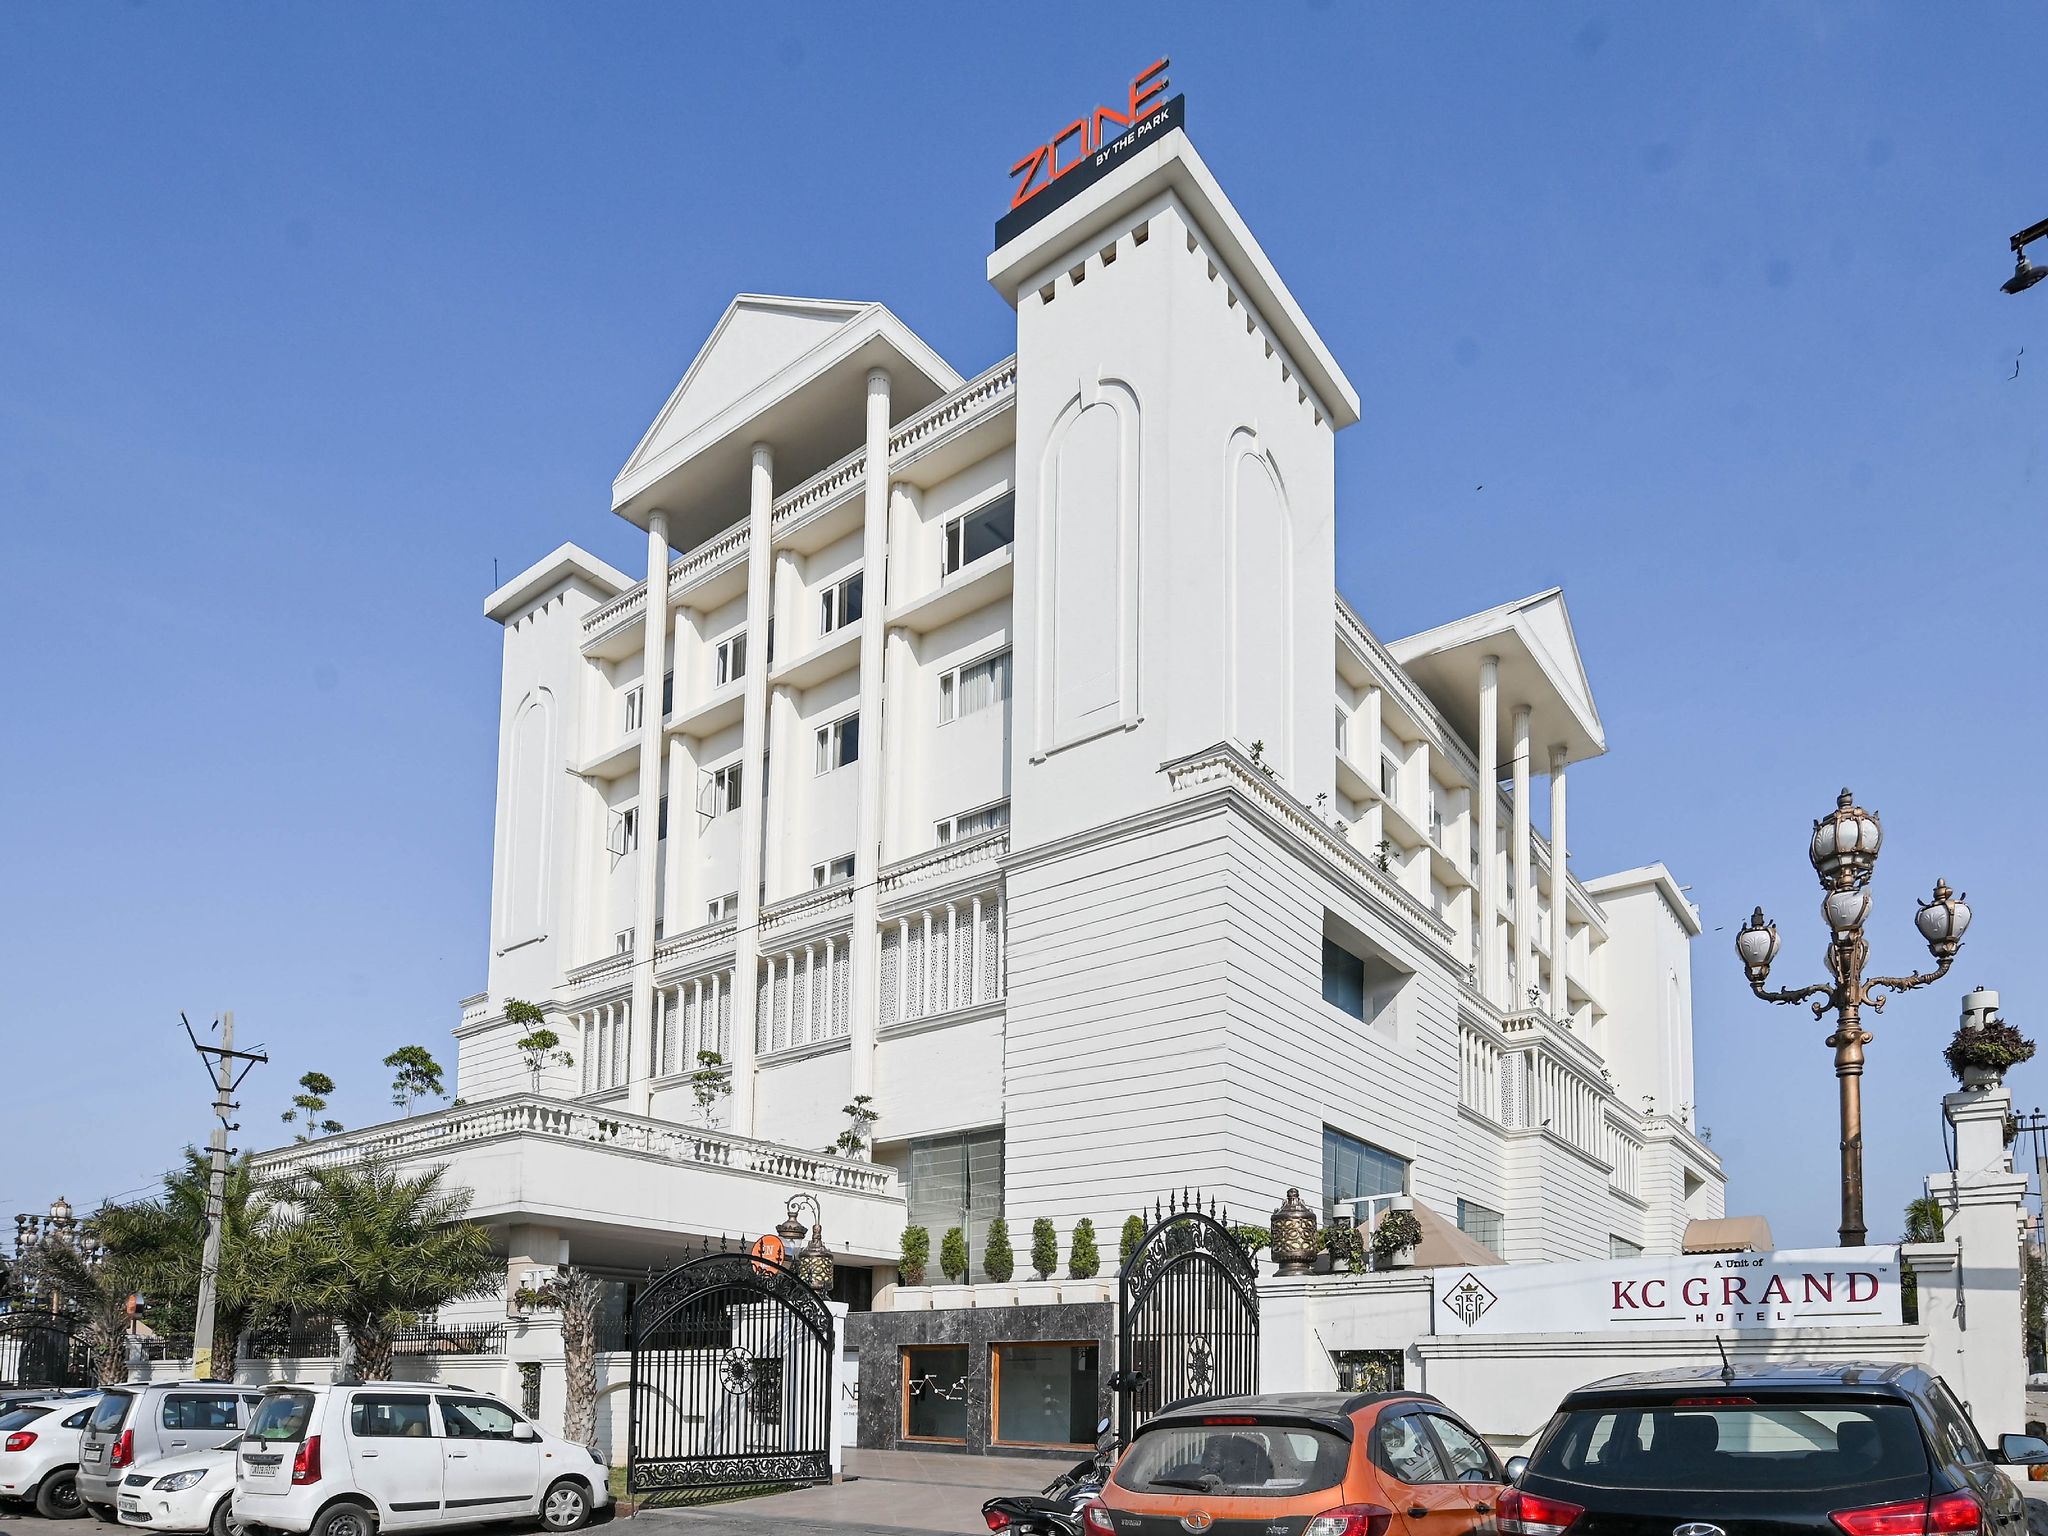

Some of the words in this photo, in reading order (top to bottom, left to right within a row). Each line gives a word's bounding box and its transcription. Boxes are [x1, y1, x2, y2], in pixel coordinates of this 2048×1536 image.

[1009, 55, 1170, 211] ZONE
[1096, 148, 1111, 167] BY
[1112, 132, 1135, 154] THE
[1137, 108, 1169, 138] PARK
[1714, 1260, 1723, 1269] A
[1725, 1259, 1749, 1268] Unit
[1752, 1258, 1764, 1267] of
[1611, 1279, 1666, 1310] KC
[1682, 1272, 1879, 1306] GRAND
[1695, 1312, 1786, 1323] HOTEL
